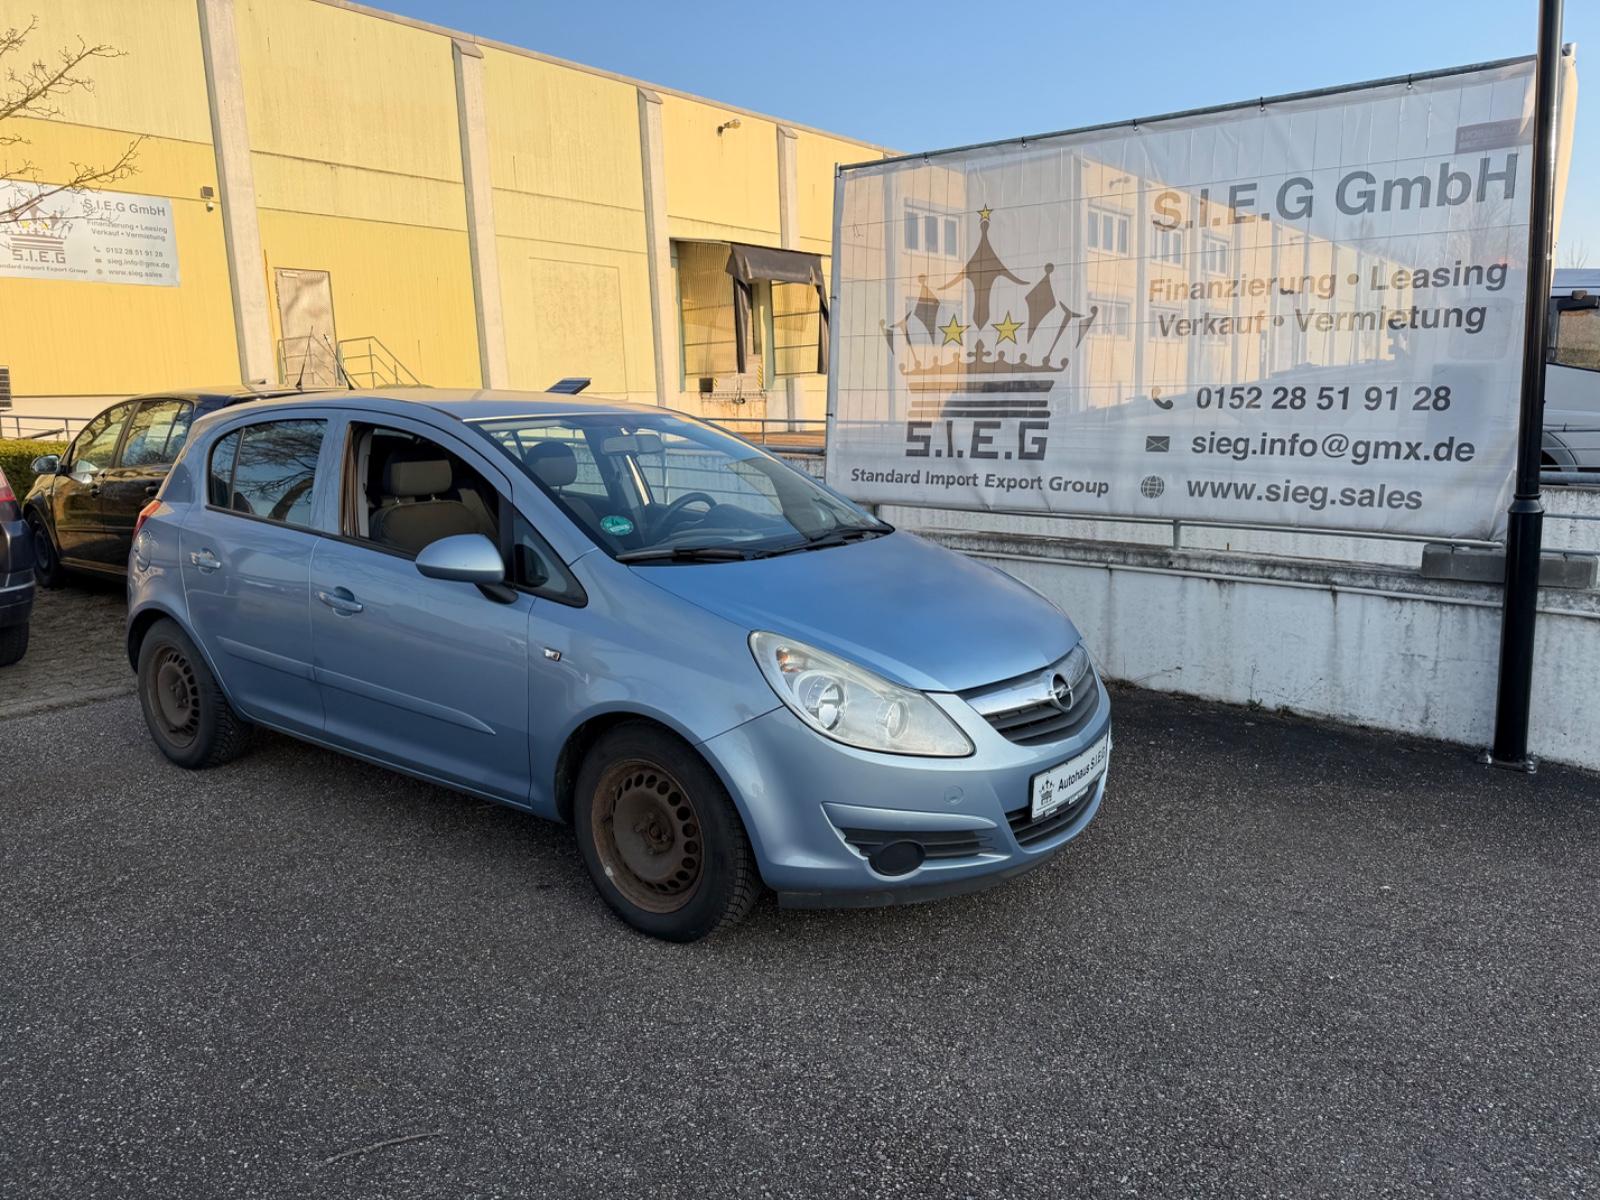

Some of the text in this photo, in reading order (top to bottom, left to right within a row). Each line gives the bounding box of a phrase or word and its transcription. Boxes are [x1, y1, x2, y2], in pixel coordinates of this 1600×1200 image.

[1152, 152, 1519, 233] S.I.E.G GmbH
[129, 203, 166, 217] GmbH
[12, 250, 66, 264] S.I.E.G
[1148, 259, 1508, 303] Finanzierung Leasing
[1157, 304, 1488, 338] Verkauf Vermietung
[1196, 385, 1452, 412] 0152 28 51 91 28
[905, 420, 1050, 461] S.I.E.G
[1191, 431, 1476, 466] sieg.info@gmx.de
[851, 468, 1110, 498] Standard Import Export Group
[1187, 478, 1423, 512] www.sieg.sales
[1058, 764, 1090, 791] Autohaus
